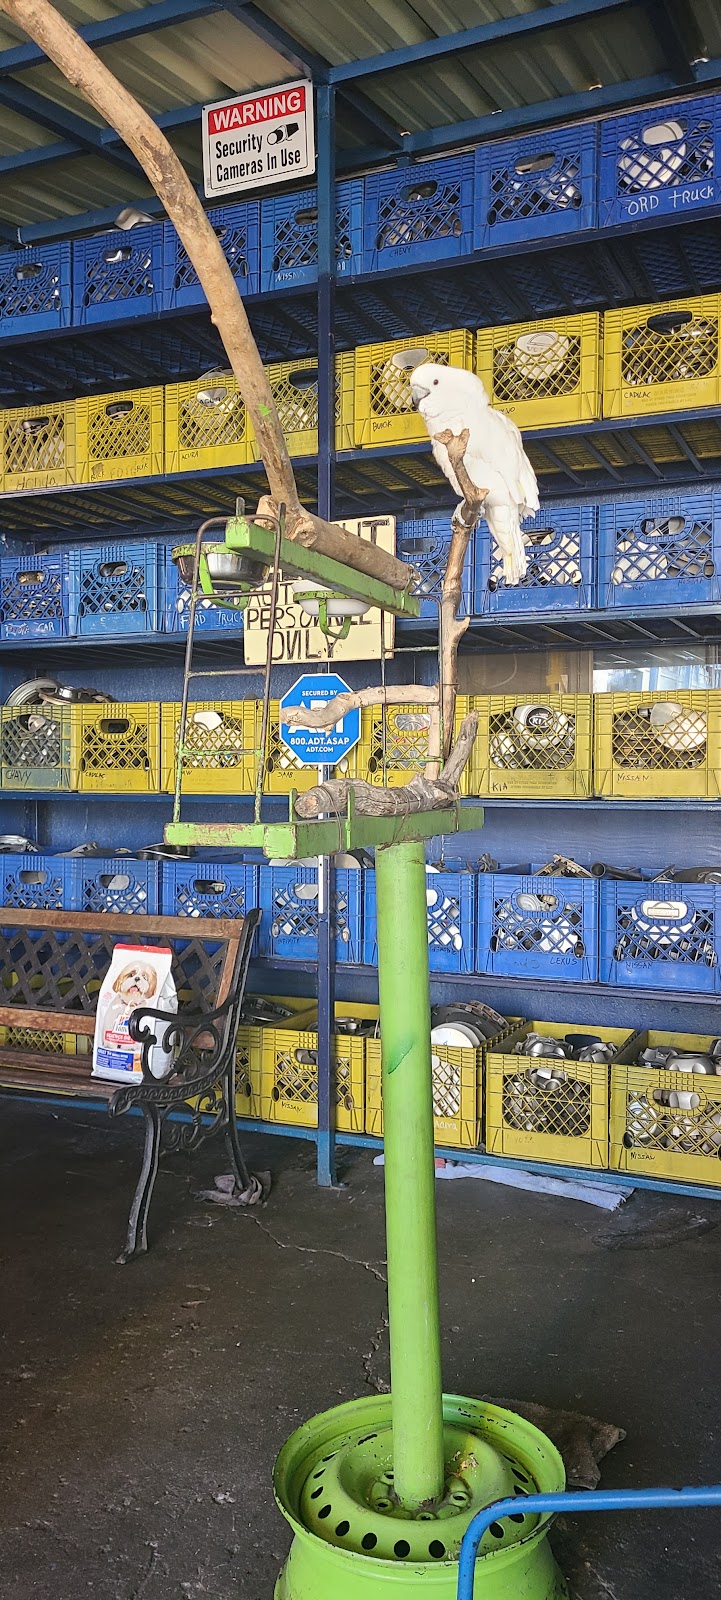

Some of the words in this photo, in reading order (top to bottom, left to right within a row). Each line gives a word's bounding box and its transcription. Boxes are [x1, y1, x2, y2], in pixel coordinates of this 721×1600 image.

[213, 91, 301, 131] WARNING
[215, 133, 263, 159] Security
[216, 159, 263, 182] Cameras
[267, 152, 277, 170] In
[280, 148, 301, 167] Use
[180, 611, 206, 629] FRD
[246, 605, 372, 630] PERSOL
[290, 737, 350, 745] 800.ADT.ASAP
[373, 774, 394, 784] GC
[491, 782, 508, 792] KIA
[550, 956, 578, 966] LEXUS
